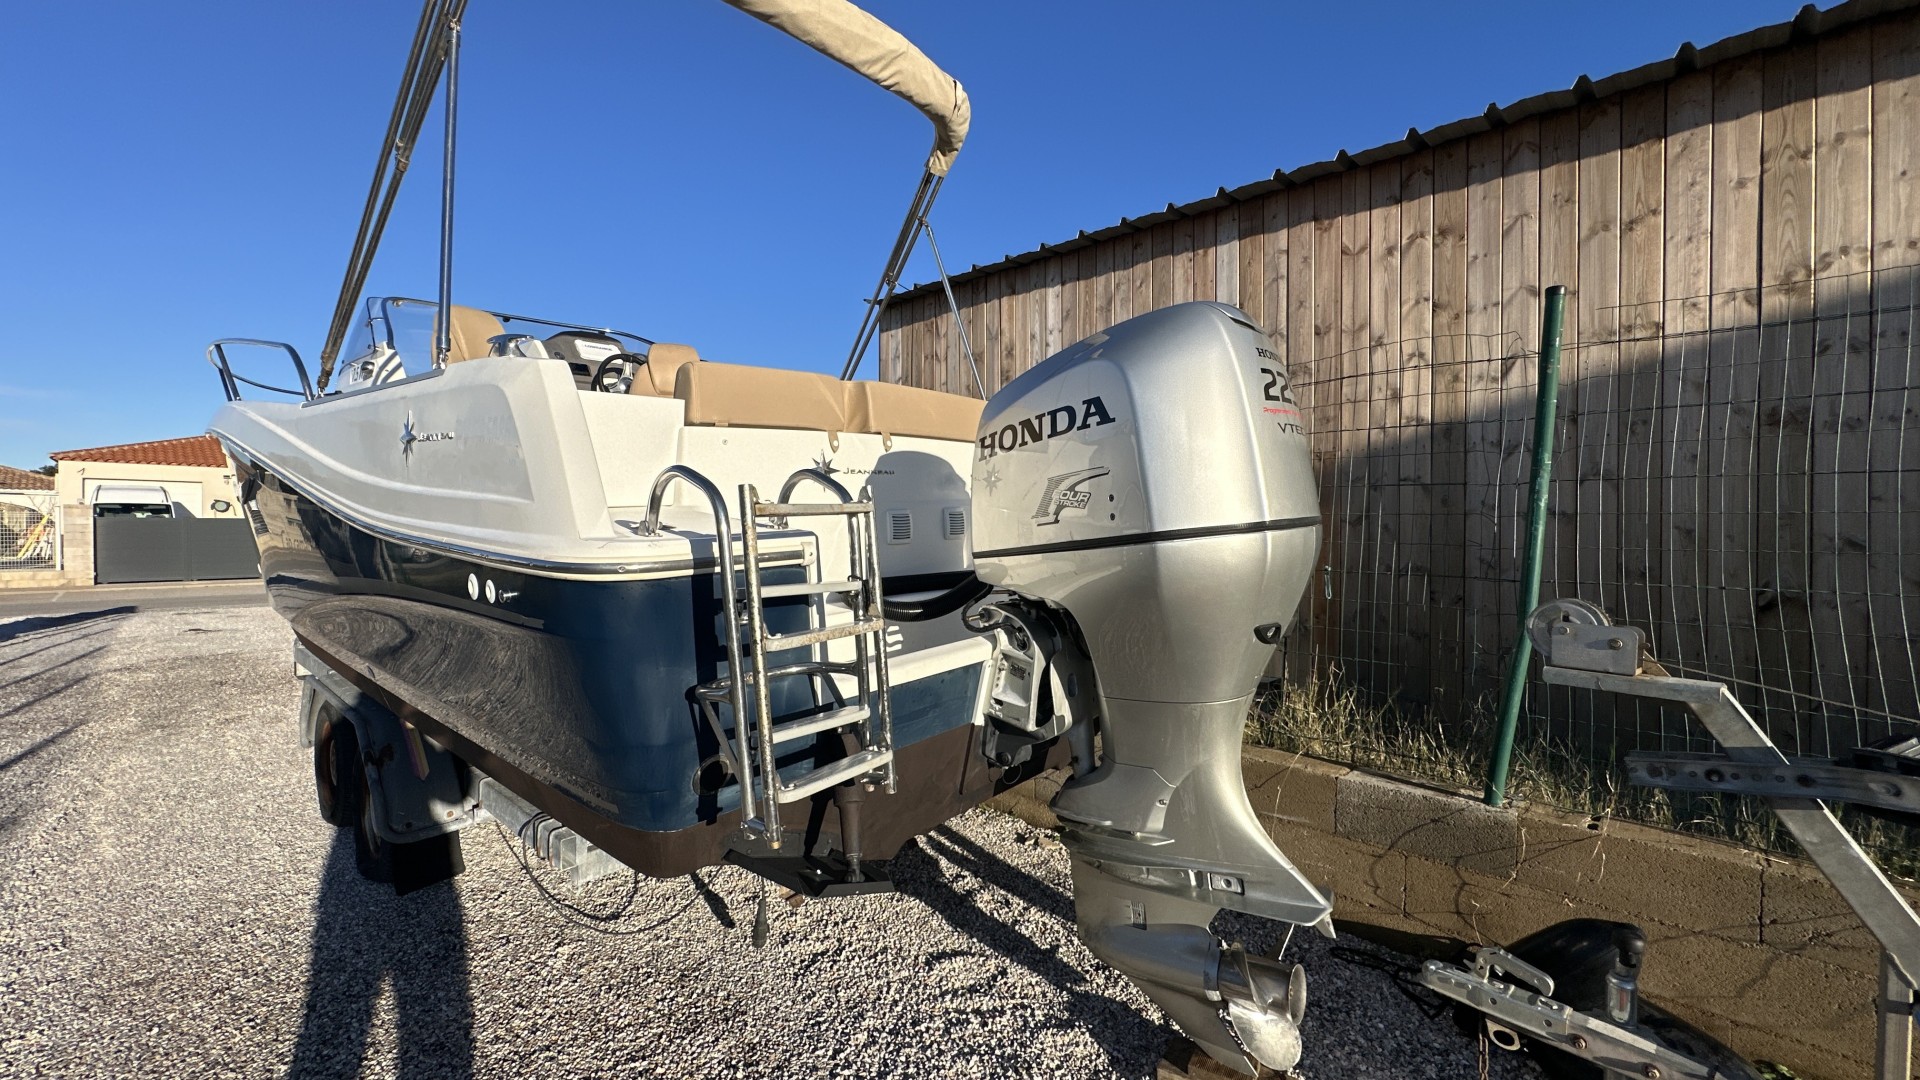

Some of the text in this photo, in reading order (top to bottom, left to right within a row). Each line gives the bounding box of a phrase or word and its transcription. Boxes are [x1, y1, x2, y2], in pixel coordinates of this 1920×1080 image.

[1260, 368, 1297, 405] 22
[978, 396, 1115, 462] HONDA
[1054, 500, 1087, 508] STROKE
